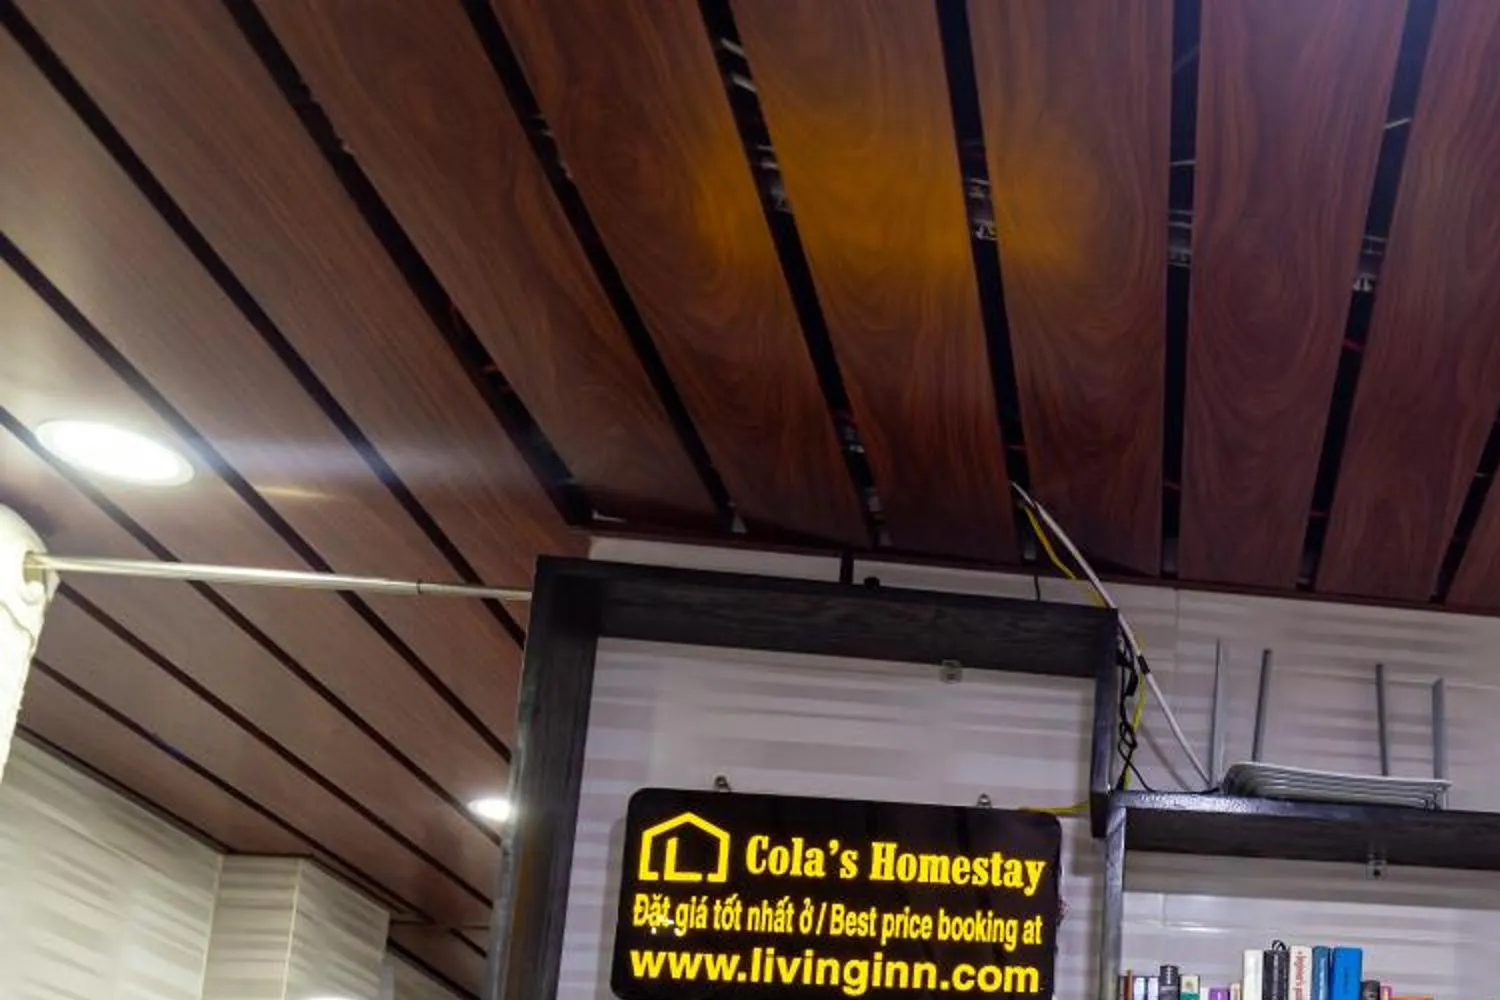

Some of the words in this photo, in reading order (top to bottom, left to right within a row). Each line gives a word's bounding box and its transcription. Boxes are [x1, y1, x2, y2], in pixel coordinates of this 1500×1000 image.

[745, 834, 859, 881] Cola's
[869, 841, 1046, 895] Homestay
[633, 891, 671, 934] Đặt
[676, 895, 708, 937] giá
[713, 893, 742, 931] tốt
[747, 895, 794, 934] nhất
[799, 897, 814, 934] ở
[815, 901, 827, 936] /
[830, 903, 877, 938] Best
[881, 908, 933, 946] price
[938, 908, 1017, 951] booking
[1022, 917, 1043, 945] at
[630, 947, 1039, 997] www.livinginn.com
